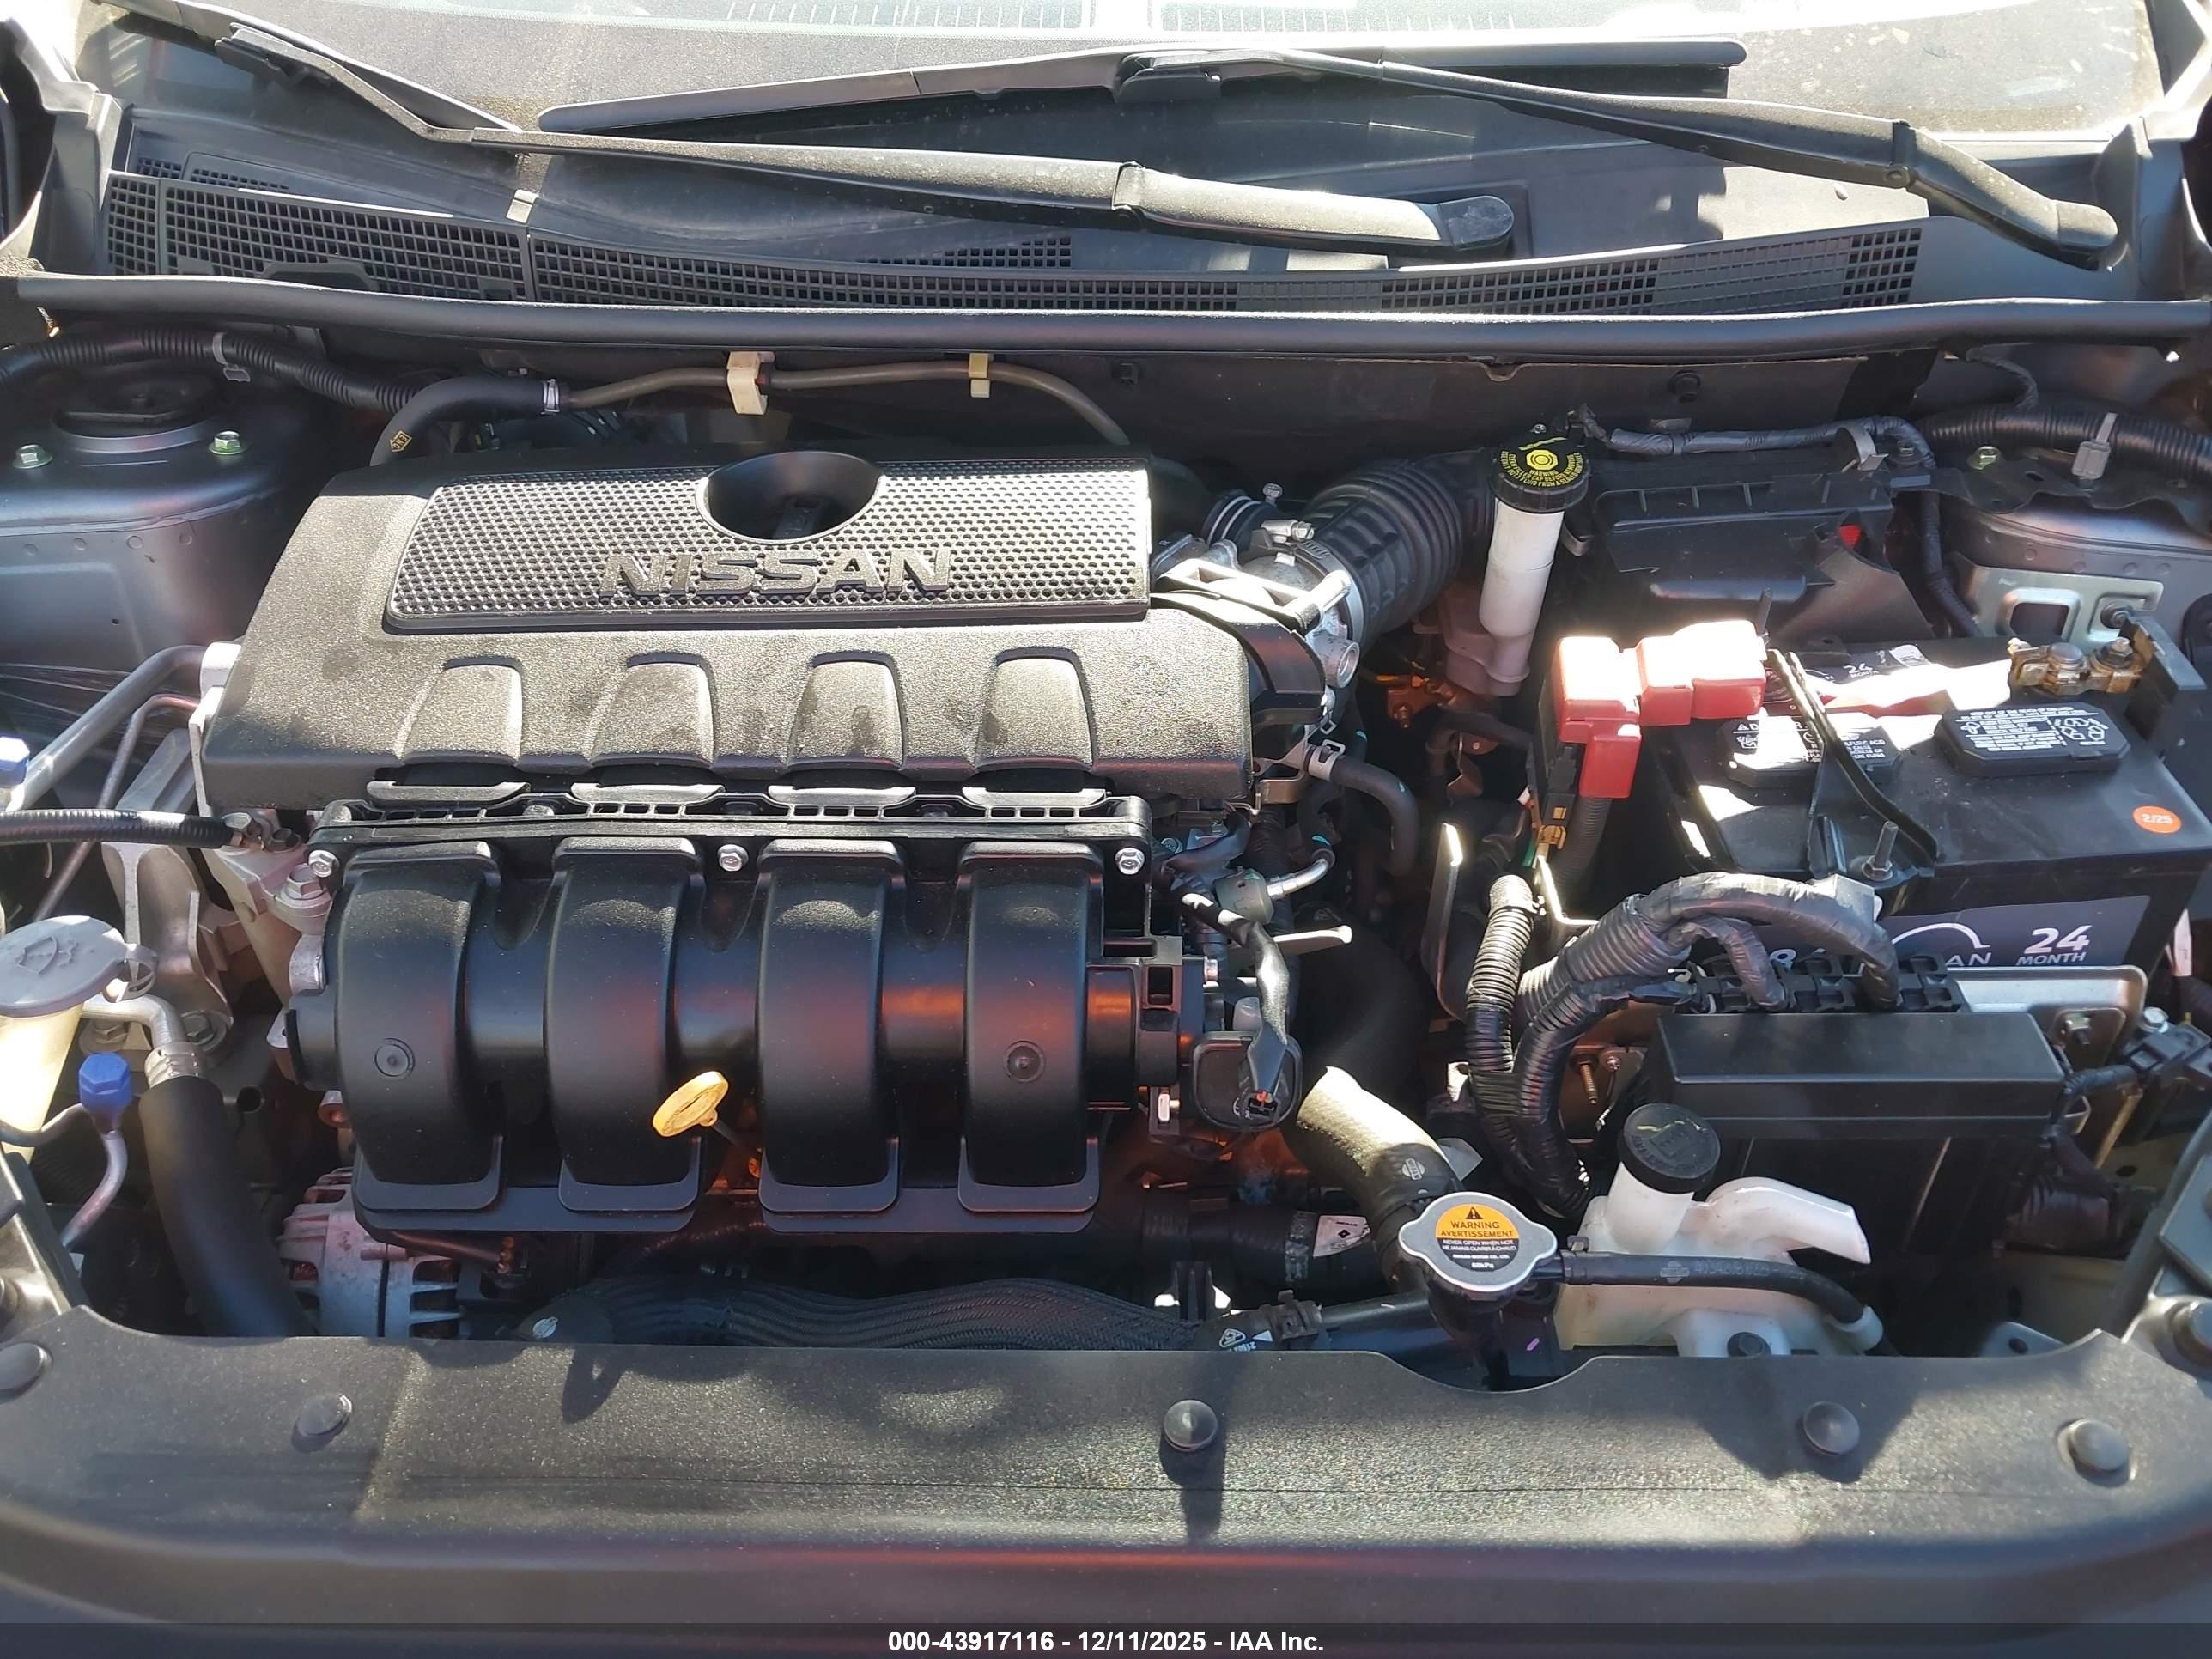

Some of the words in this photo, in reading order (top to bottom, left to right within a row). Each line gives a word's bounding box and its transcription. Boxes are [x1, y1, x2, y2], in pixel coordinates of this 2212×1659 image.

[1520, 476, 1538, 486] FLUID
[599, 548, 951, 597] NISSAN
[2024, 925, 2093, 954] 24
[2016, 951, 2087, 966] MONTH
